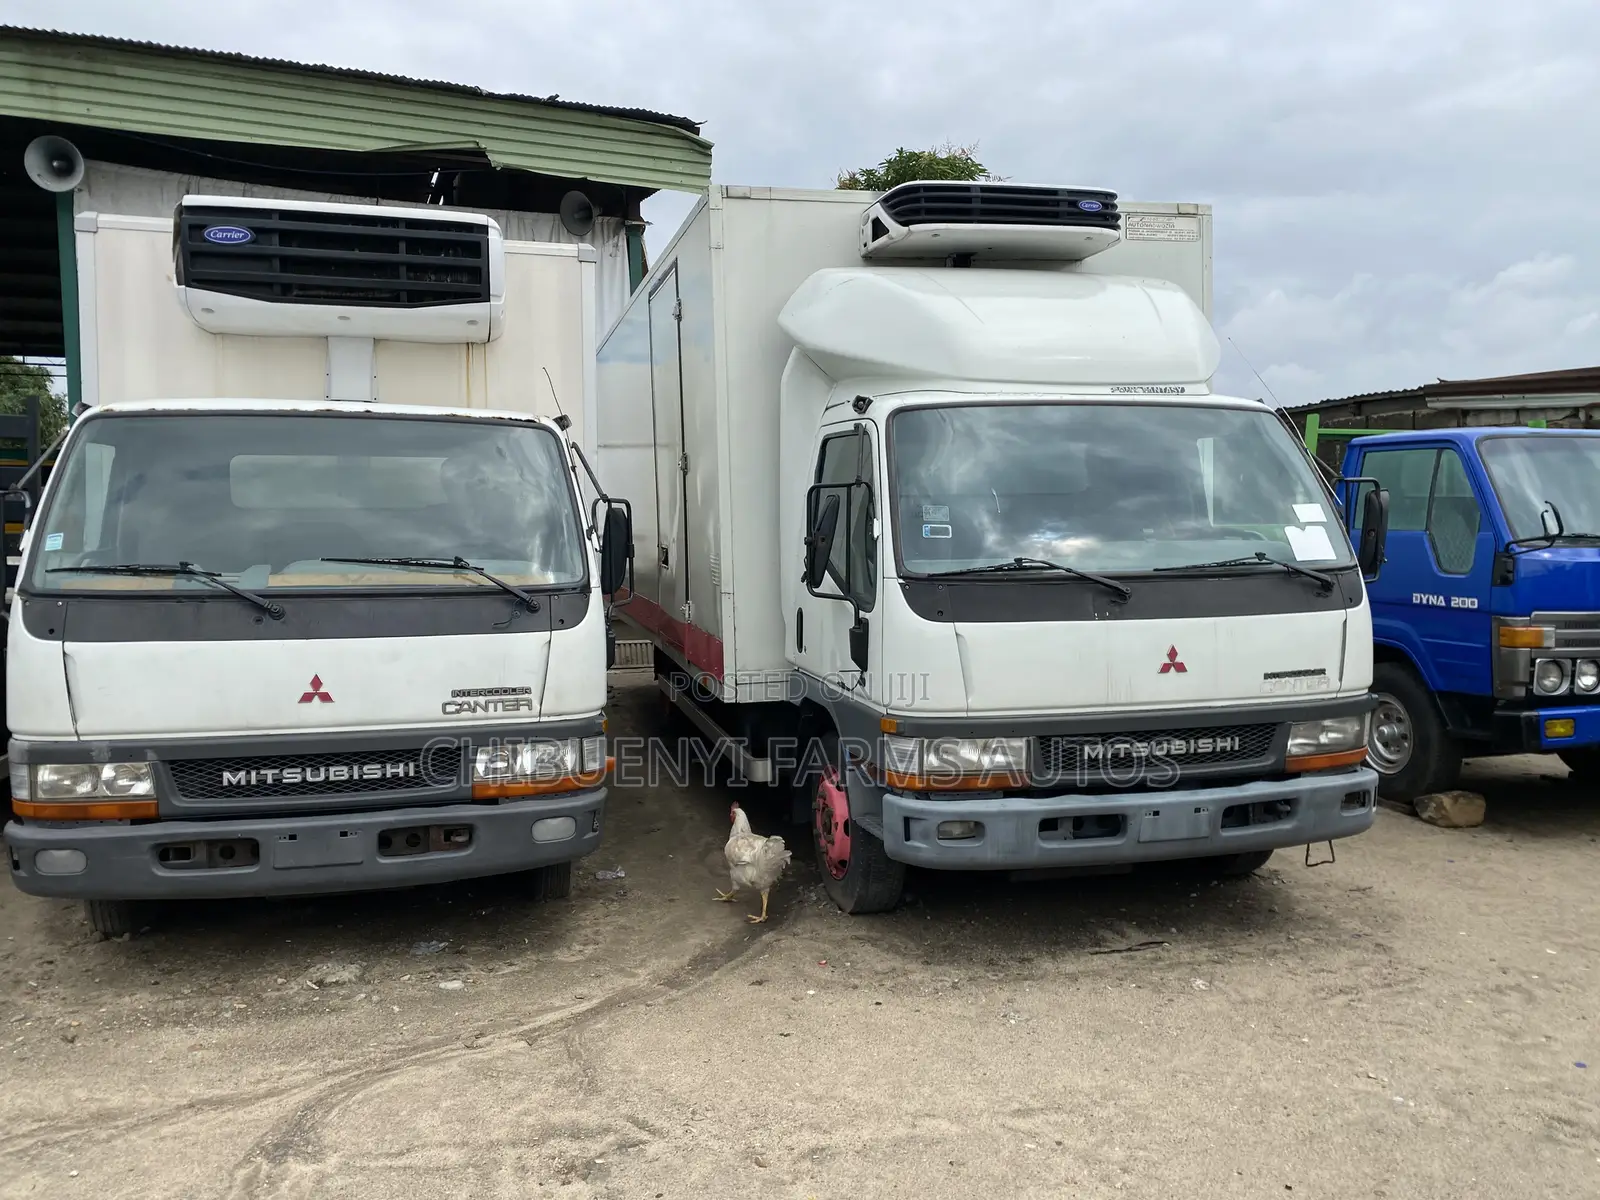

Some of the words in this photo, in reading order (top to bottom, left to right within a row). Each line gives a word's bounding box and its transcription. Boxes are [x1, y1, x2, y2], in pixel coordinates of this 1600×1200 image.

[210, 230, 245, 239] Carrier
[1412, 592, 1447, 607] DYNA
[1450, 596, 1479, 609] 200
[451, 686, 532, 698] INTERCOOLER
[441, 697, 533, 715] CANTER
[1084, 736, 1240, 760] MITSUBISHI
[221, 761, 416, 787] MITSUBISHI
